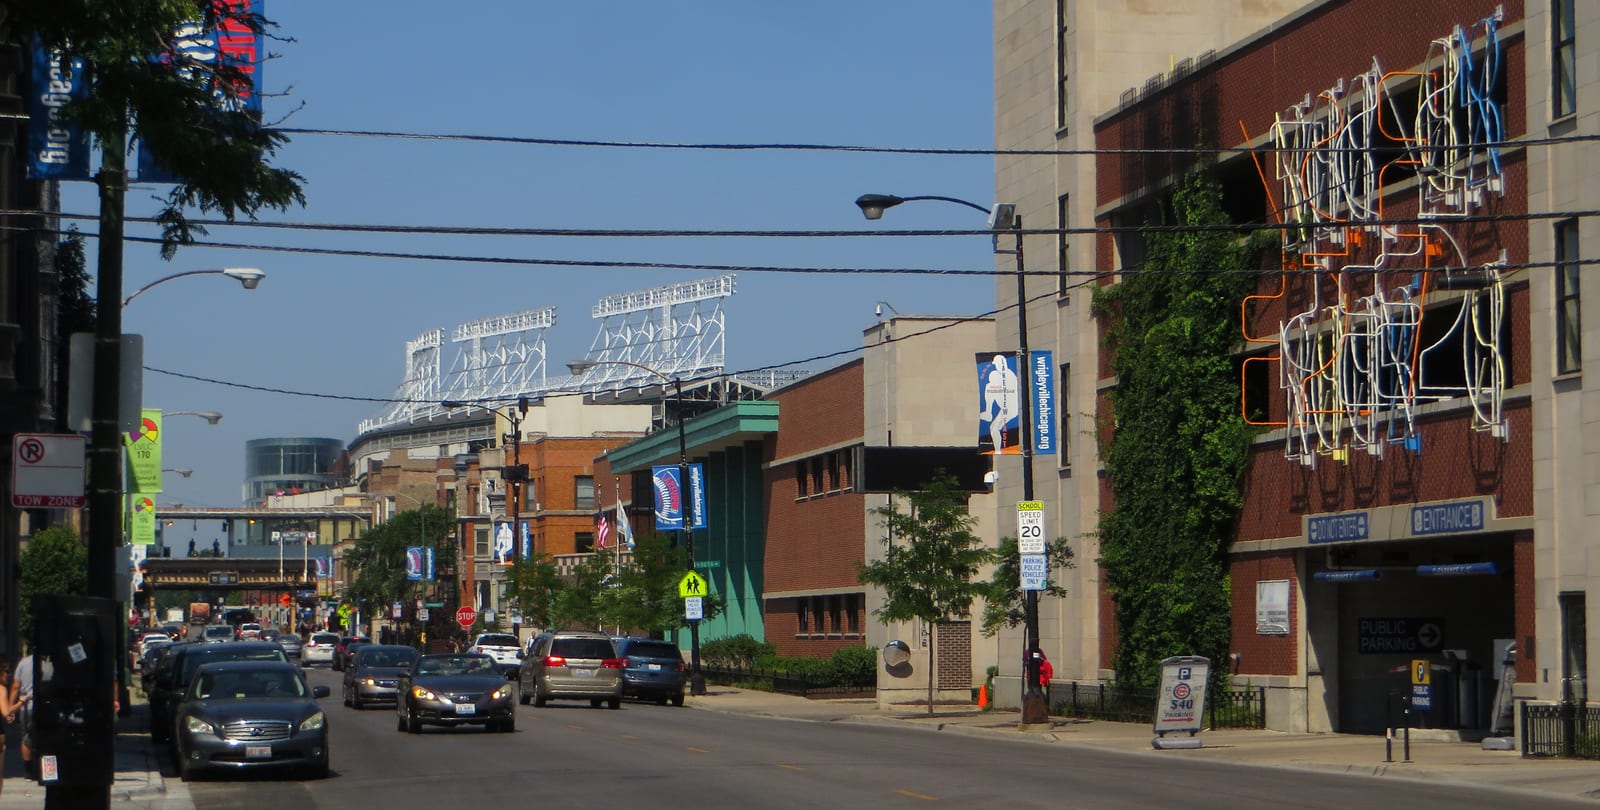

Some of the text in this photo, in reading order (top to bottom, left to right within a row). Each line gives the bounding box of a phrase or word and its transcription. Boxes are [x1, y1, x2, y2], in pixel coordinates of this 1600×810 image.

[1035, 356, 1051, 450] wrigleyvillechicago.org
[137, 450, 151, 459] 170
[18, 495, 79, 506] TOW ZONE
[1423, 504, 1471, 531] ENTRANCE
[1021, 525, 1041, 538] 20
[1318, 516, 1357, 540] DO NOT ENTER
[458, 611, 476, 620] STOP
[1360, 620, 1407, 635] PUBLIC
[1360, 637, 1417, 652] PARKING
